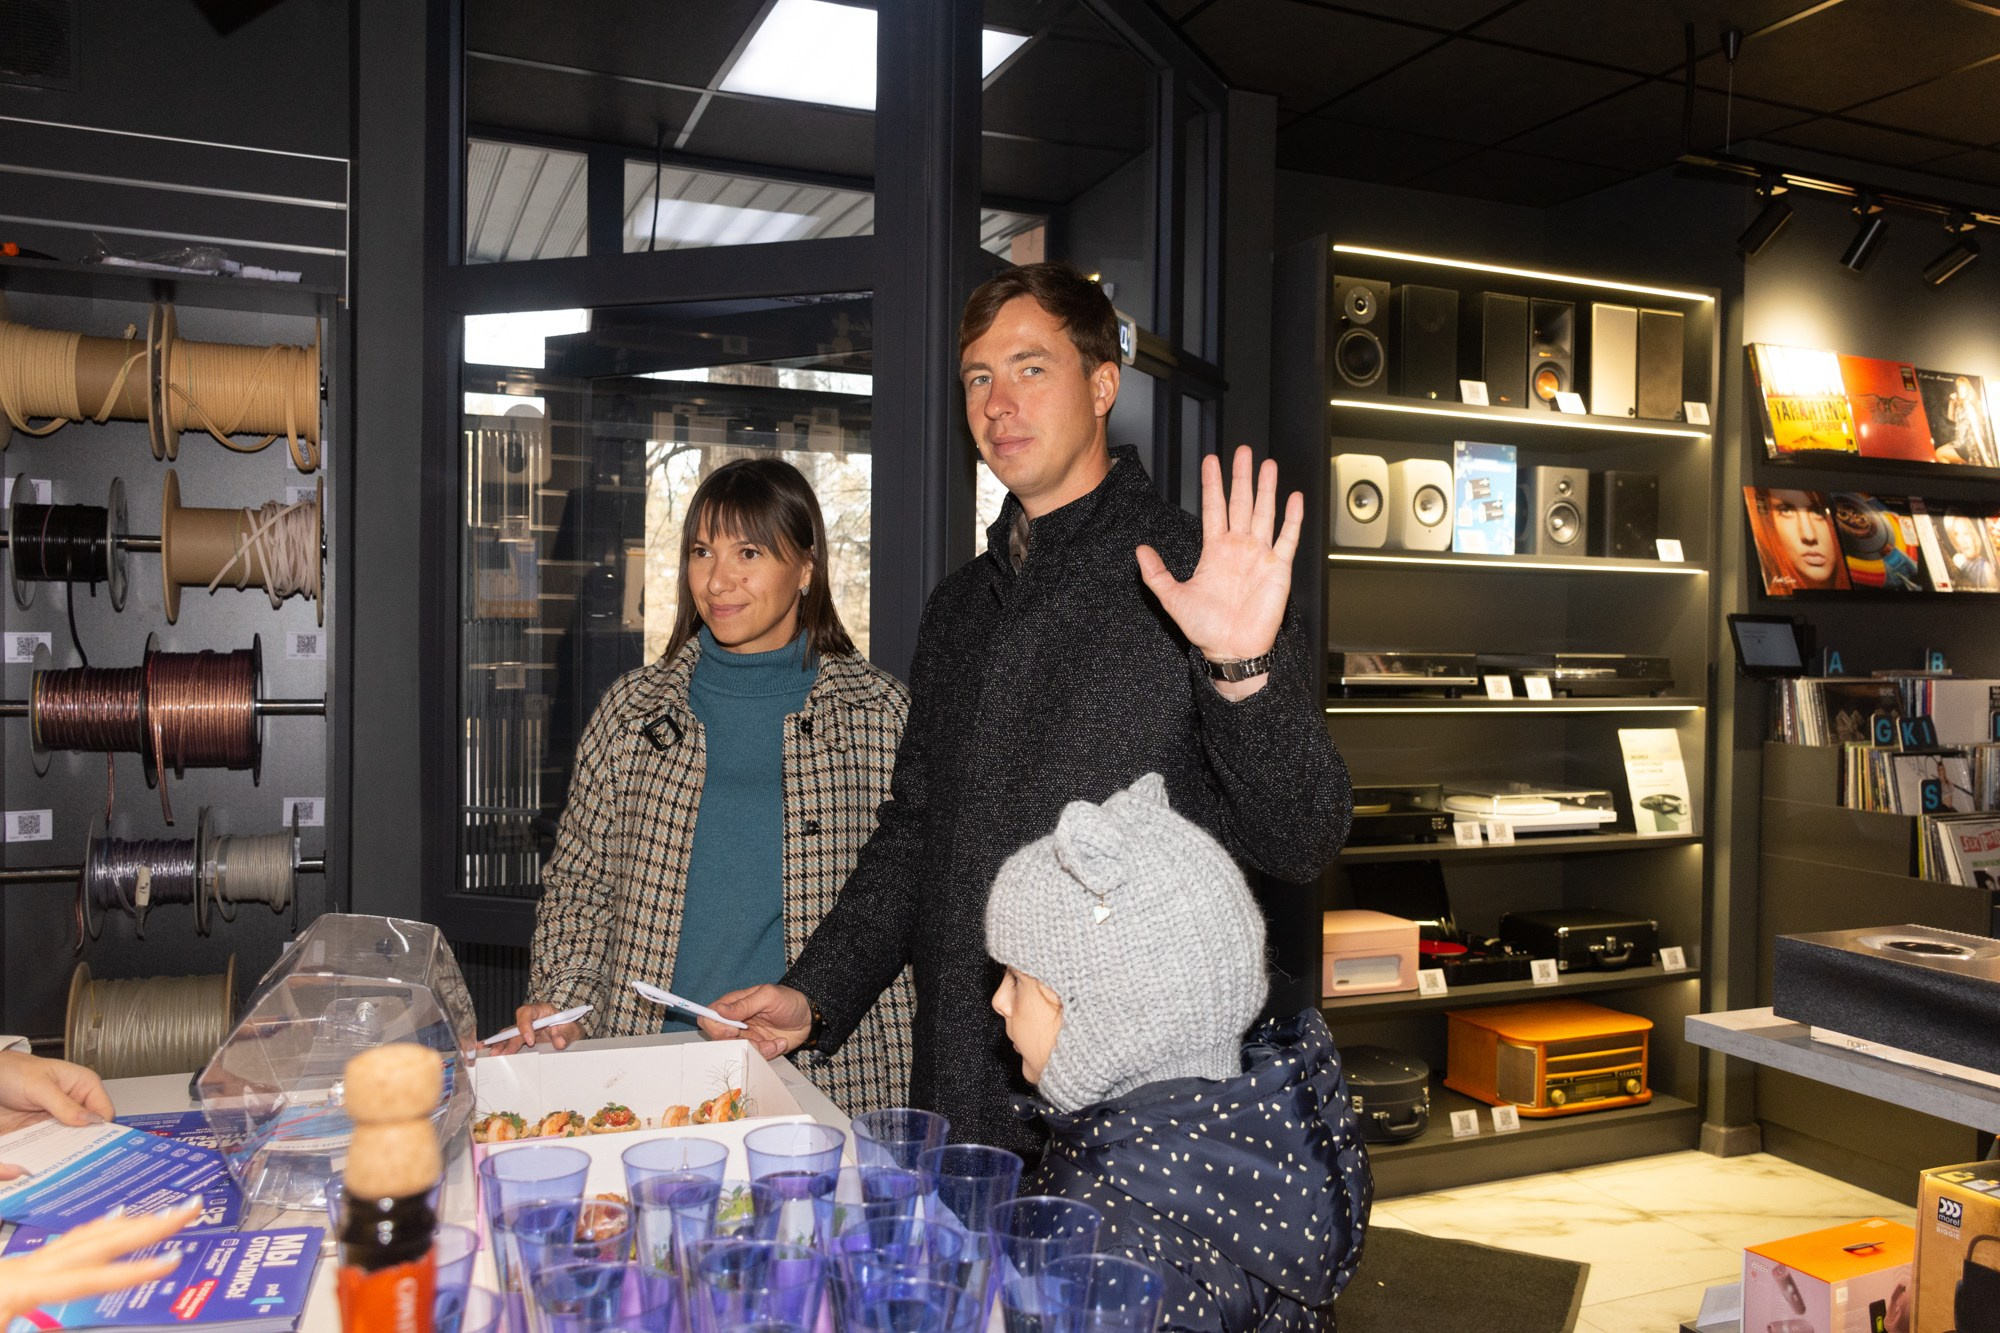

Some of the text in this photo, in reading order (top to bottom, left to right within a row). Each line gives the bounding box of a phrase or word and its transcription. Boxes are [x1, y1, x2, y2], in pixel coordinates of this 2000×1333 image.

[1770, 400, 1847, 423] TARANTINO
[1829, 651, 1843, 673] A
[1931, 652, 1944, 672] B
[1875, 719, 1892, 743] G
[1902, 722, 1918, 746] K
[1924, 784, 1939, 809] S
[184, 1212, 224, 1228] М
[1938, 1214, 1960, 1227] morel
[262, 1234, 308, 1267] МЫ
[225, 1236, 271, 1299] ОТКРЫЛИСЬ!
